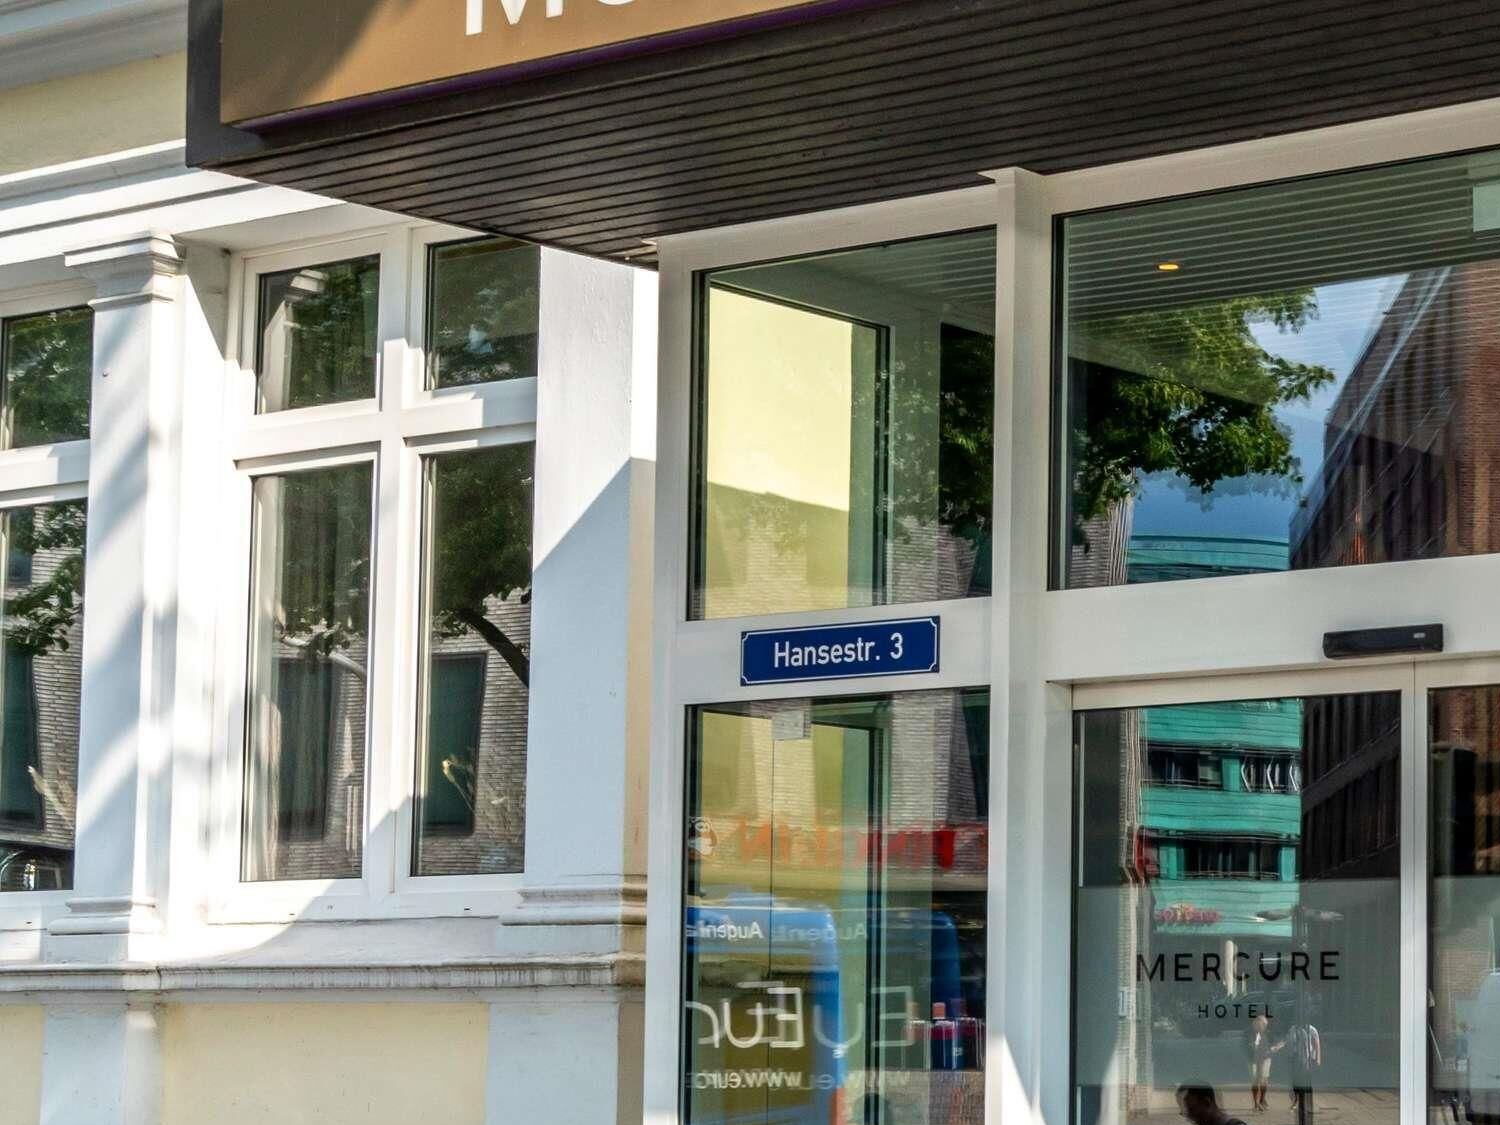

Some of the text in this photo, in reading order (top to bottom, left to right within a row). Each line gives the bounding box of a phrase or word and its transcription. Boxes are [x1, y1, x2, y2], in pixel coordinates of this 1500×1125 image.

[774, 632, 904, 668] Hansestr. 3
[1136, 951, 1340, 982] MERCURE
[1197, 1003, 1274, 1019] HOTEL
